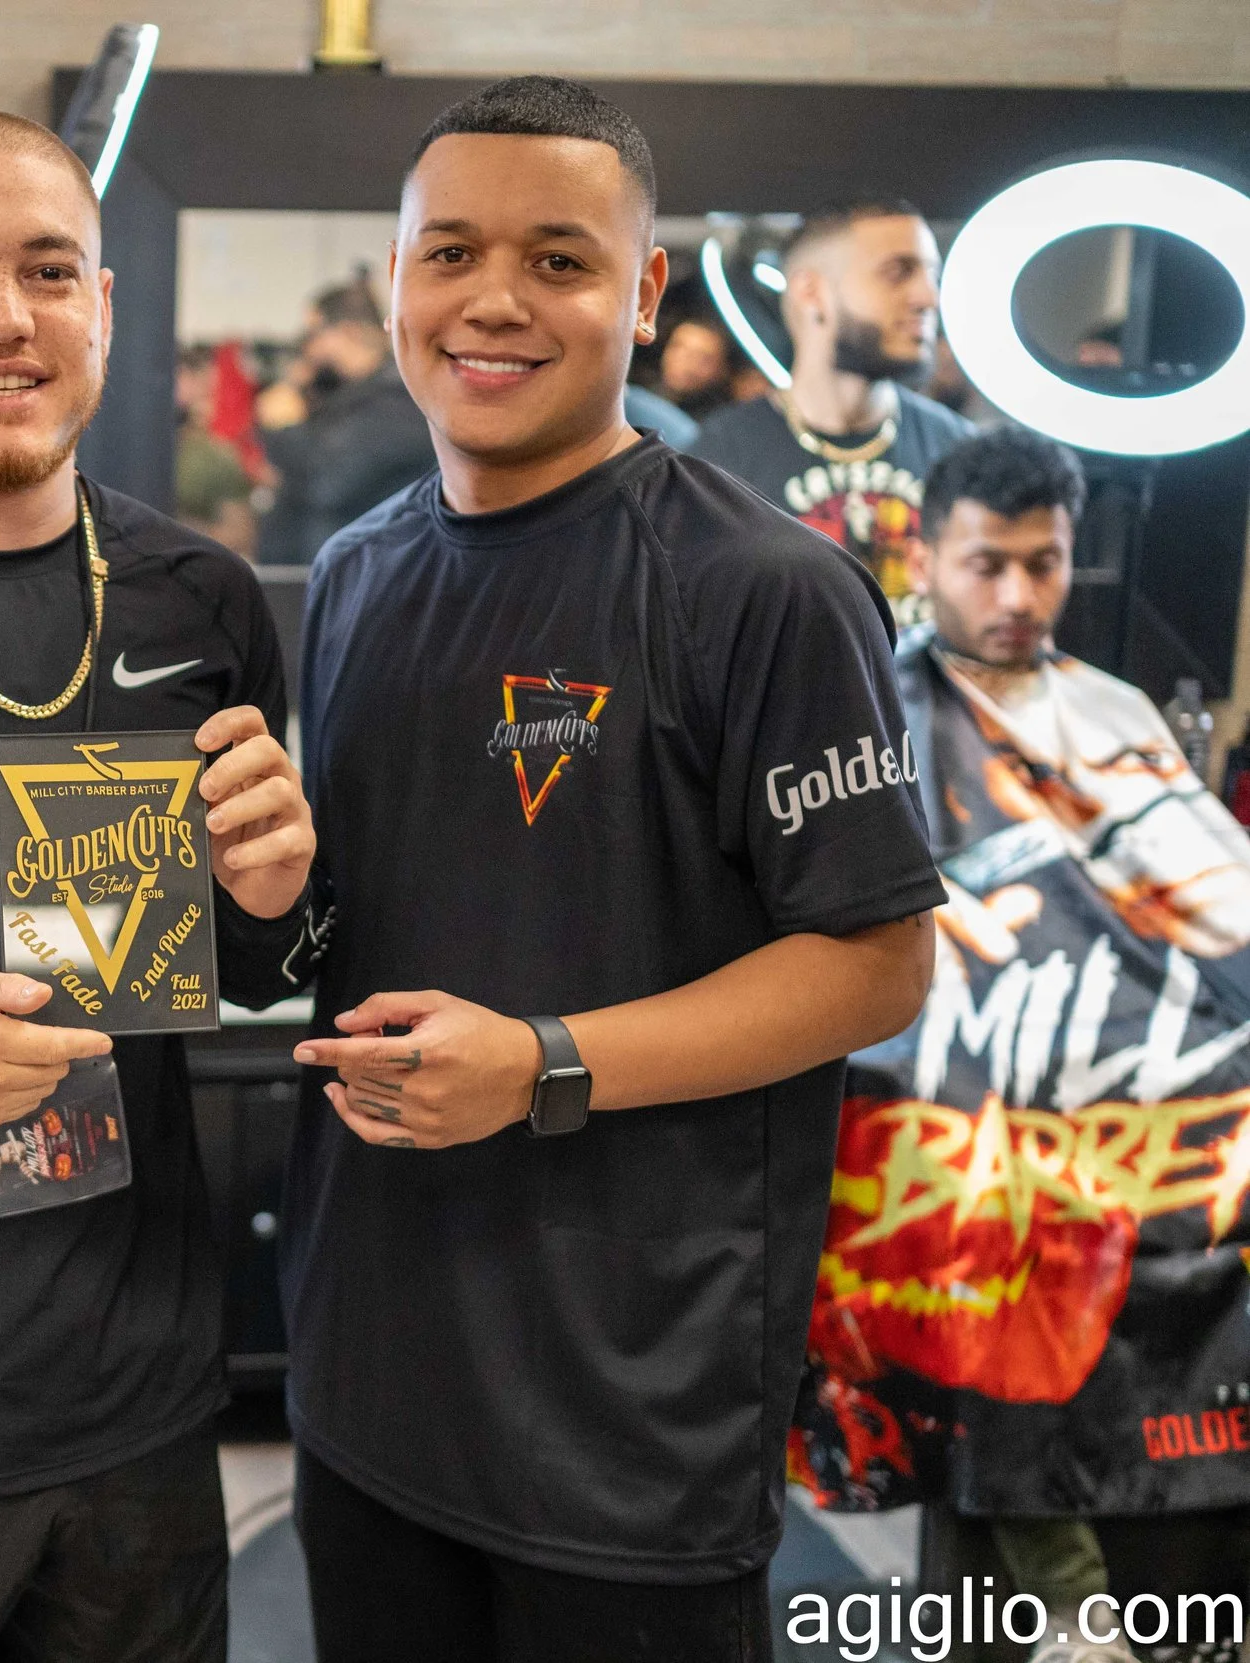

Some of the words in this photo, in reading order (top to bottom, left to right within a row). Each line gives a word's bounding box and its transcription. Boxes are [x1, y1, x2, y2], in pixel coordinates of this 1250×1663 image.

[30, 788, 55, 799] MILL
[57, 786, 82, 796] CITY
[86, 785, 127, 796] BARBER
[130, 783, 168, 795] BATTLE
[88, 874, 134, 904] Studio
[142, 889, 164, 901] 2016
[159, 903, 201, 956] Place
[8, 911, 57, 964] Fast
[52, 958, 103, 1015] Fade
[170, 974, 200, 991] Fall
[172, 992, 207, 1010] 2021
[913, 934, 1250, 1114] MILL
